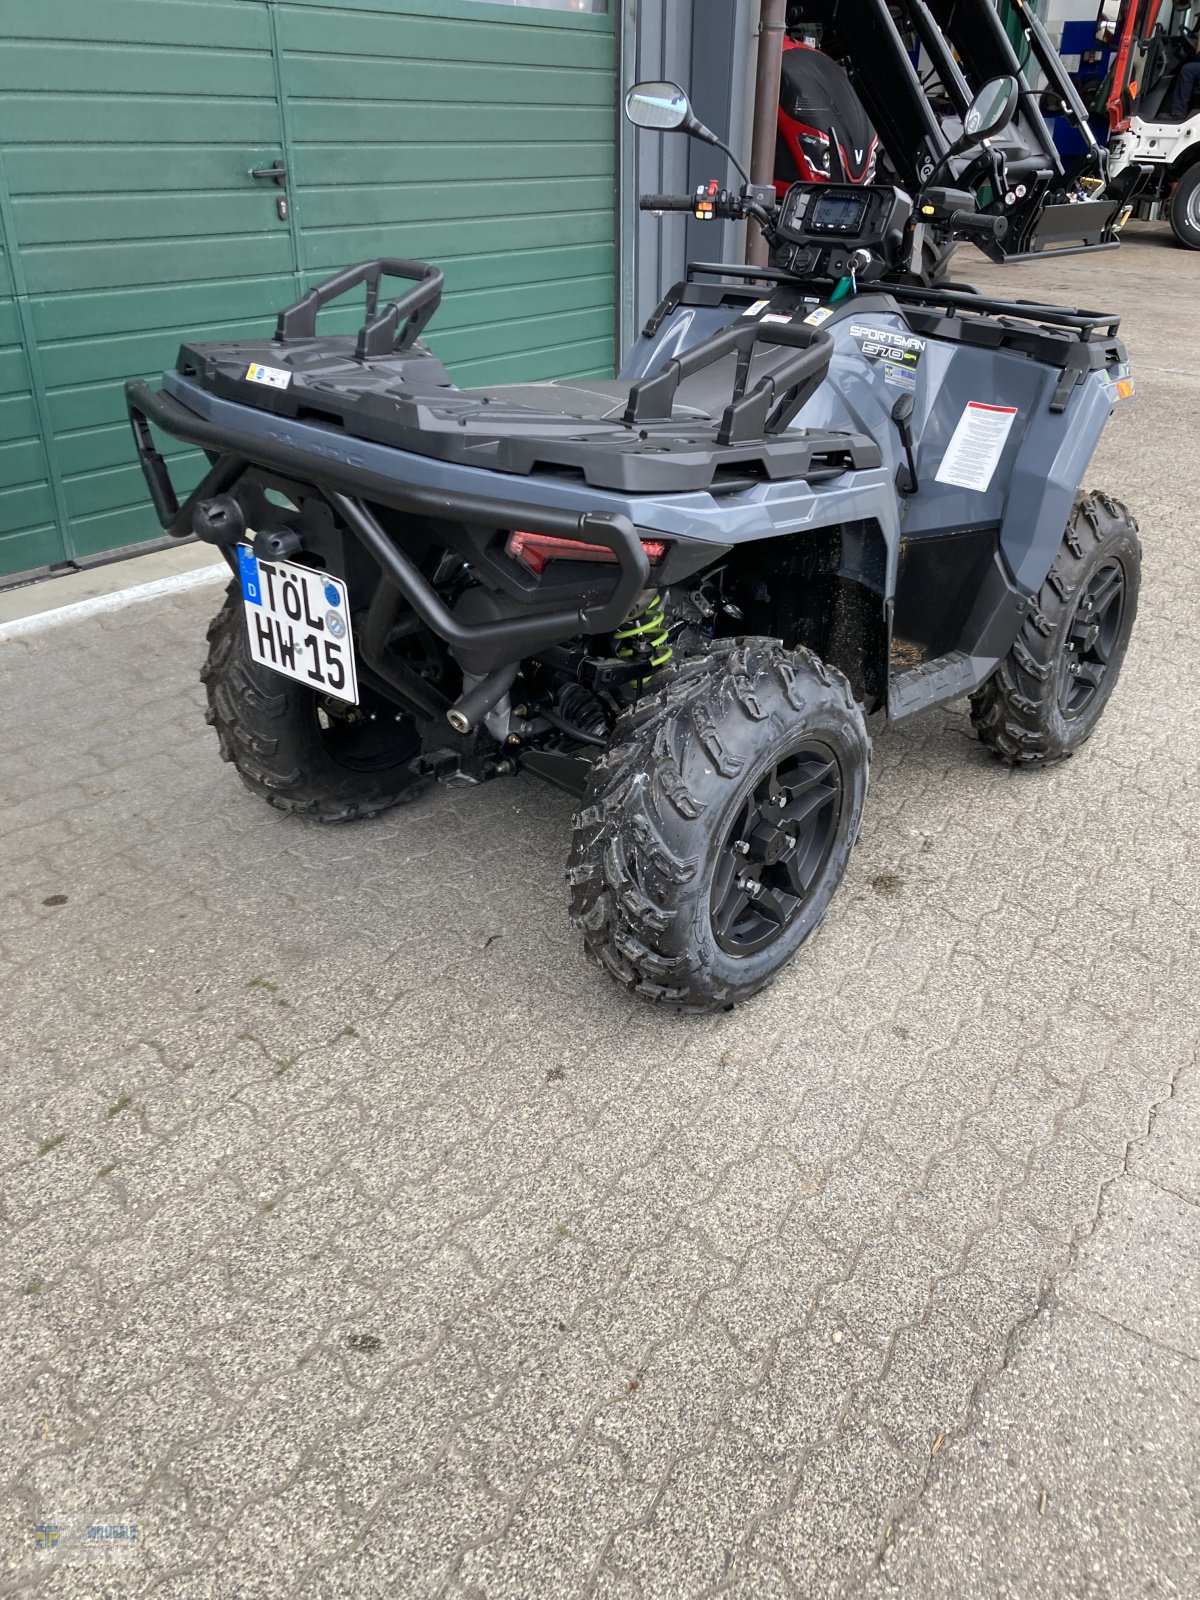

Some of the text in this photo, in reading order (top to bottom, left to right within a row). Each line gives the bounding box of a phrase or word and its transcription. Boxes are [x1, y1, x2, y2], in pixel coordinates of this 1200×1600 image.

[854, 149, 864, 165] V
[849, 325, 926, 351] SPORTSMAN
[861, 341, 904, 361] 570
[247, 583, 257, 597] D
[259, 561, 325, 631] TÖL
[254, 611, 345, 690] HW 15
